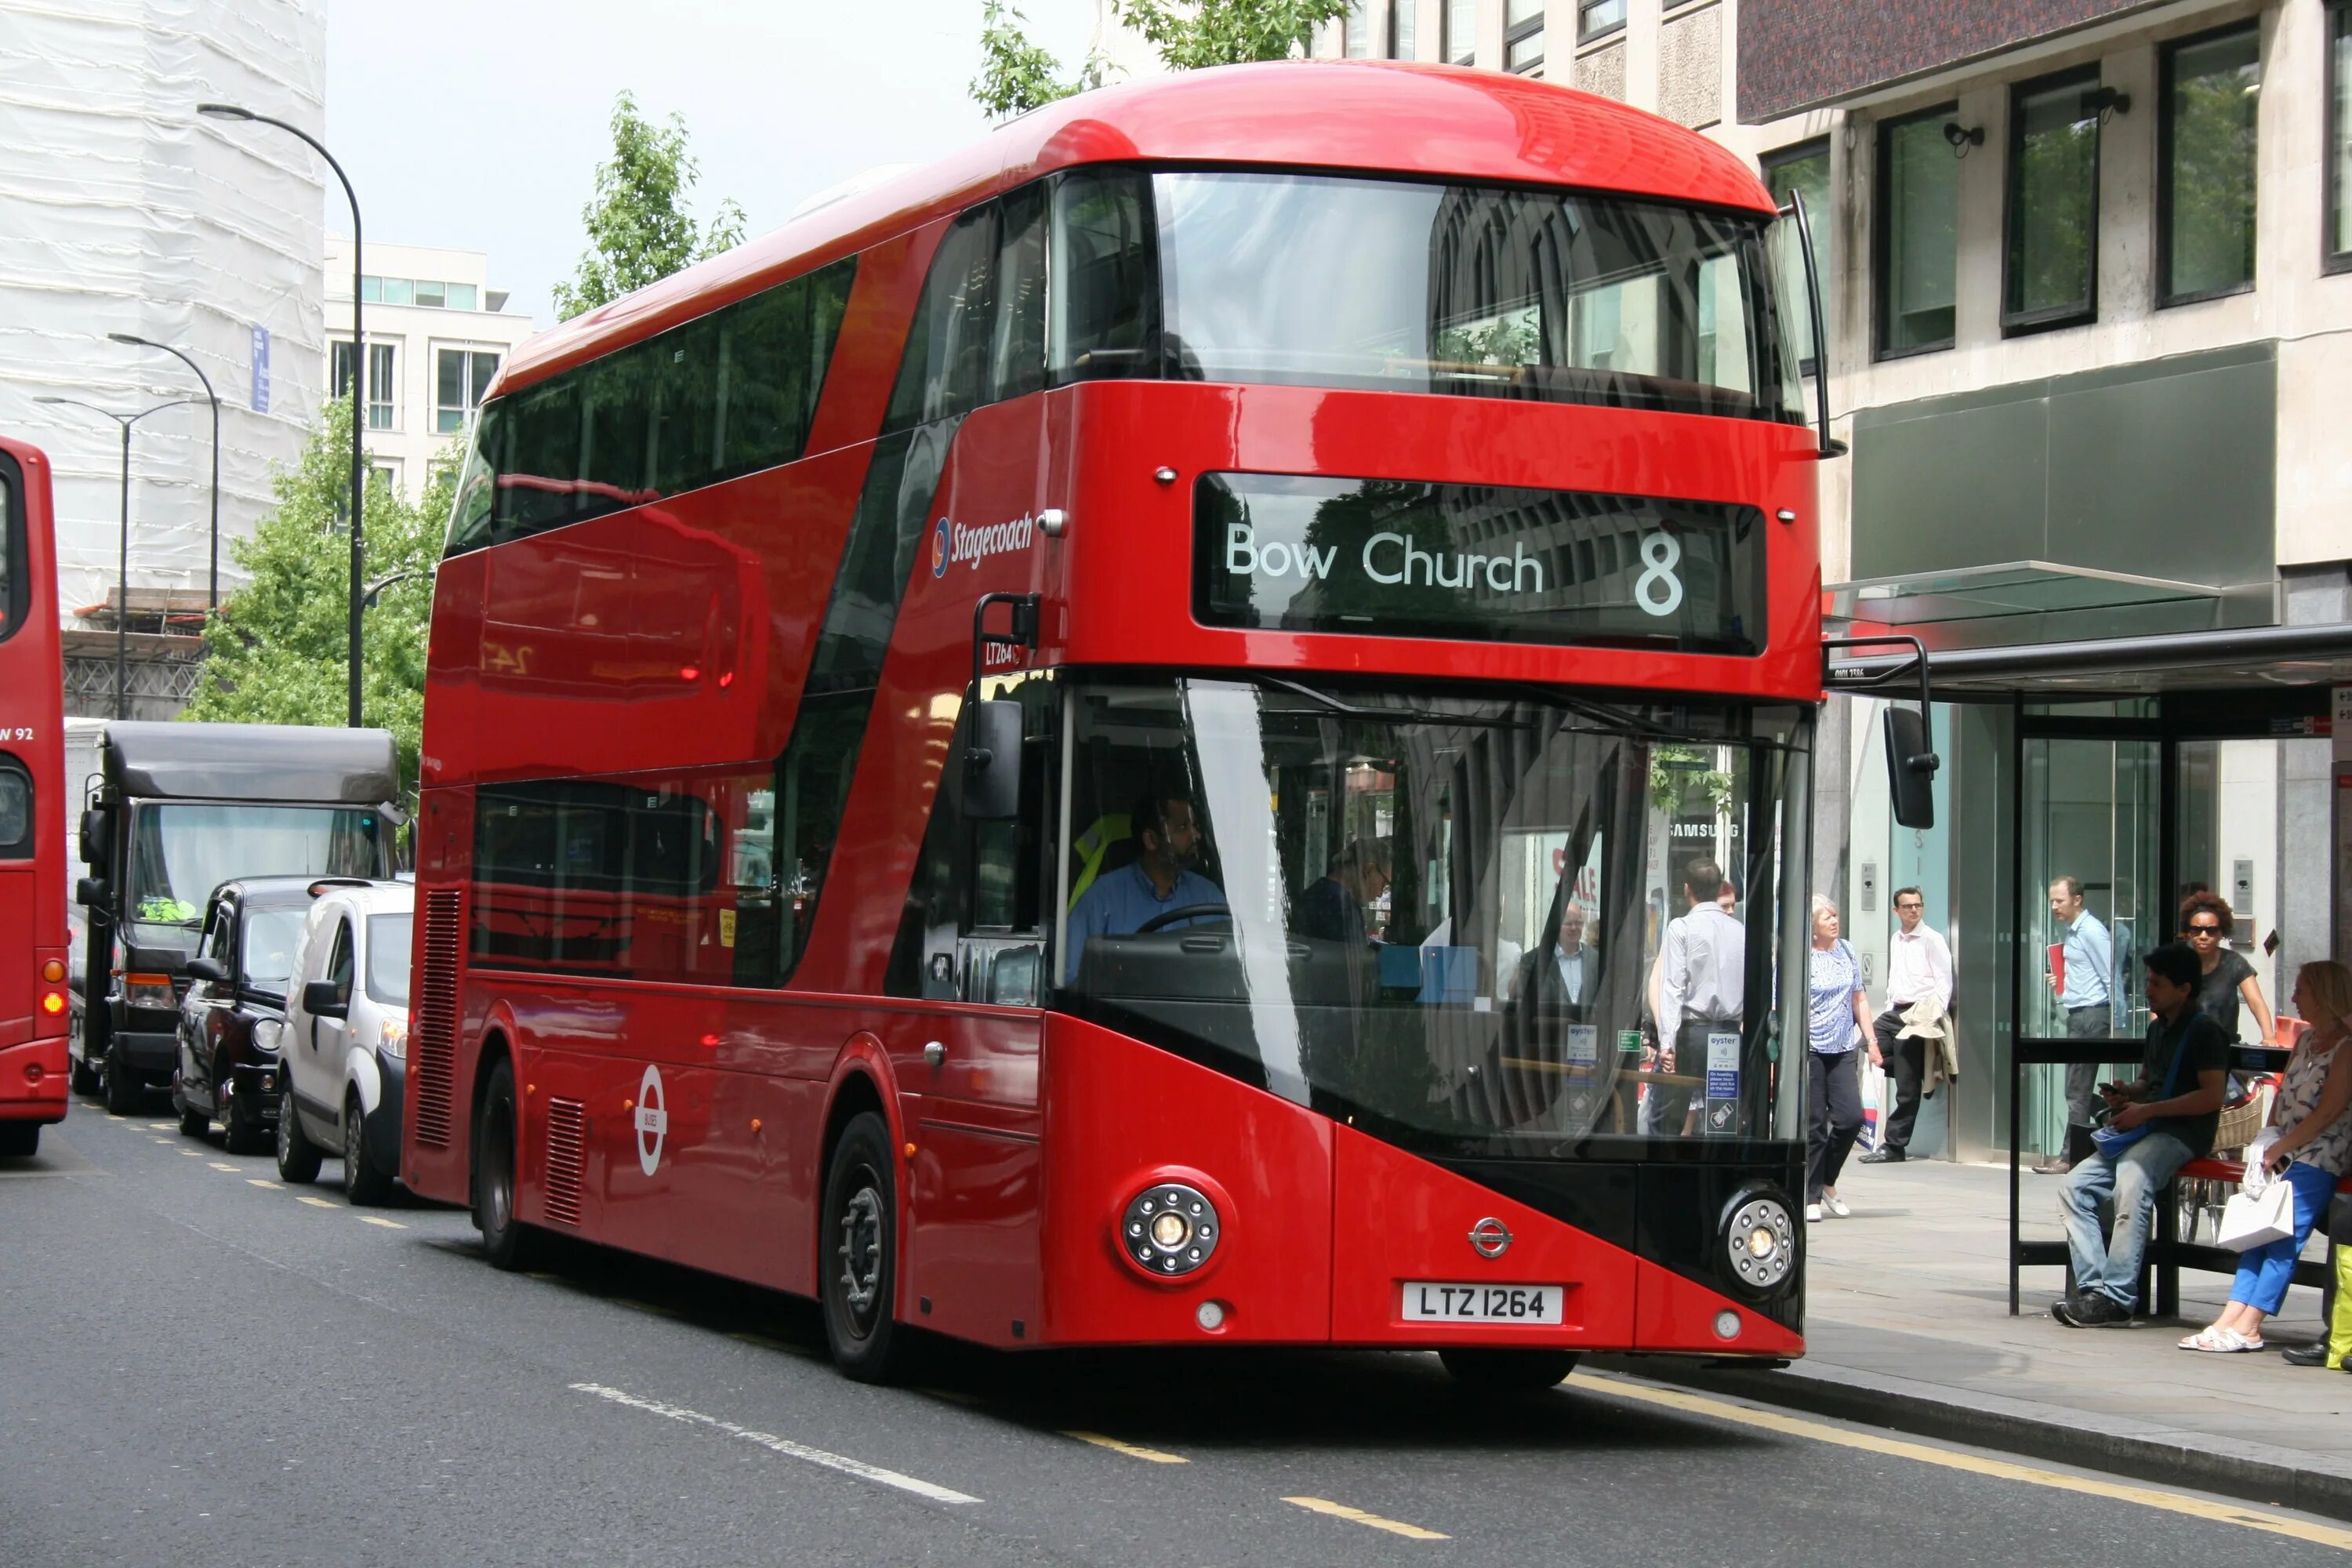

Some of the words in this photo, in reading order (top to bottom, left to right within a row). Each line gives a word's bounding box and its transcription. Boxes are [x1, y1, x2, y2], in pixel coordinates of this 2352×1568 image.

[951, 511, 1033, 570] Stagecoach
[1226, 522, 1338, 579] Bow
[1363, 532, 1543, 593] Church
[1635, 532, 1682, 617] 8
[985, 642, 1012, 666] LT264
[16, 728, 34, 741] 92
[1670, 823, 1739, 837] AMSUG
[1711, 1037, 1737, 1046] oyster
[1421, 1287, 1475, 1316] LTZ
[1483, 1290, 1544, 1318] 1264
